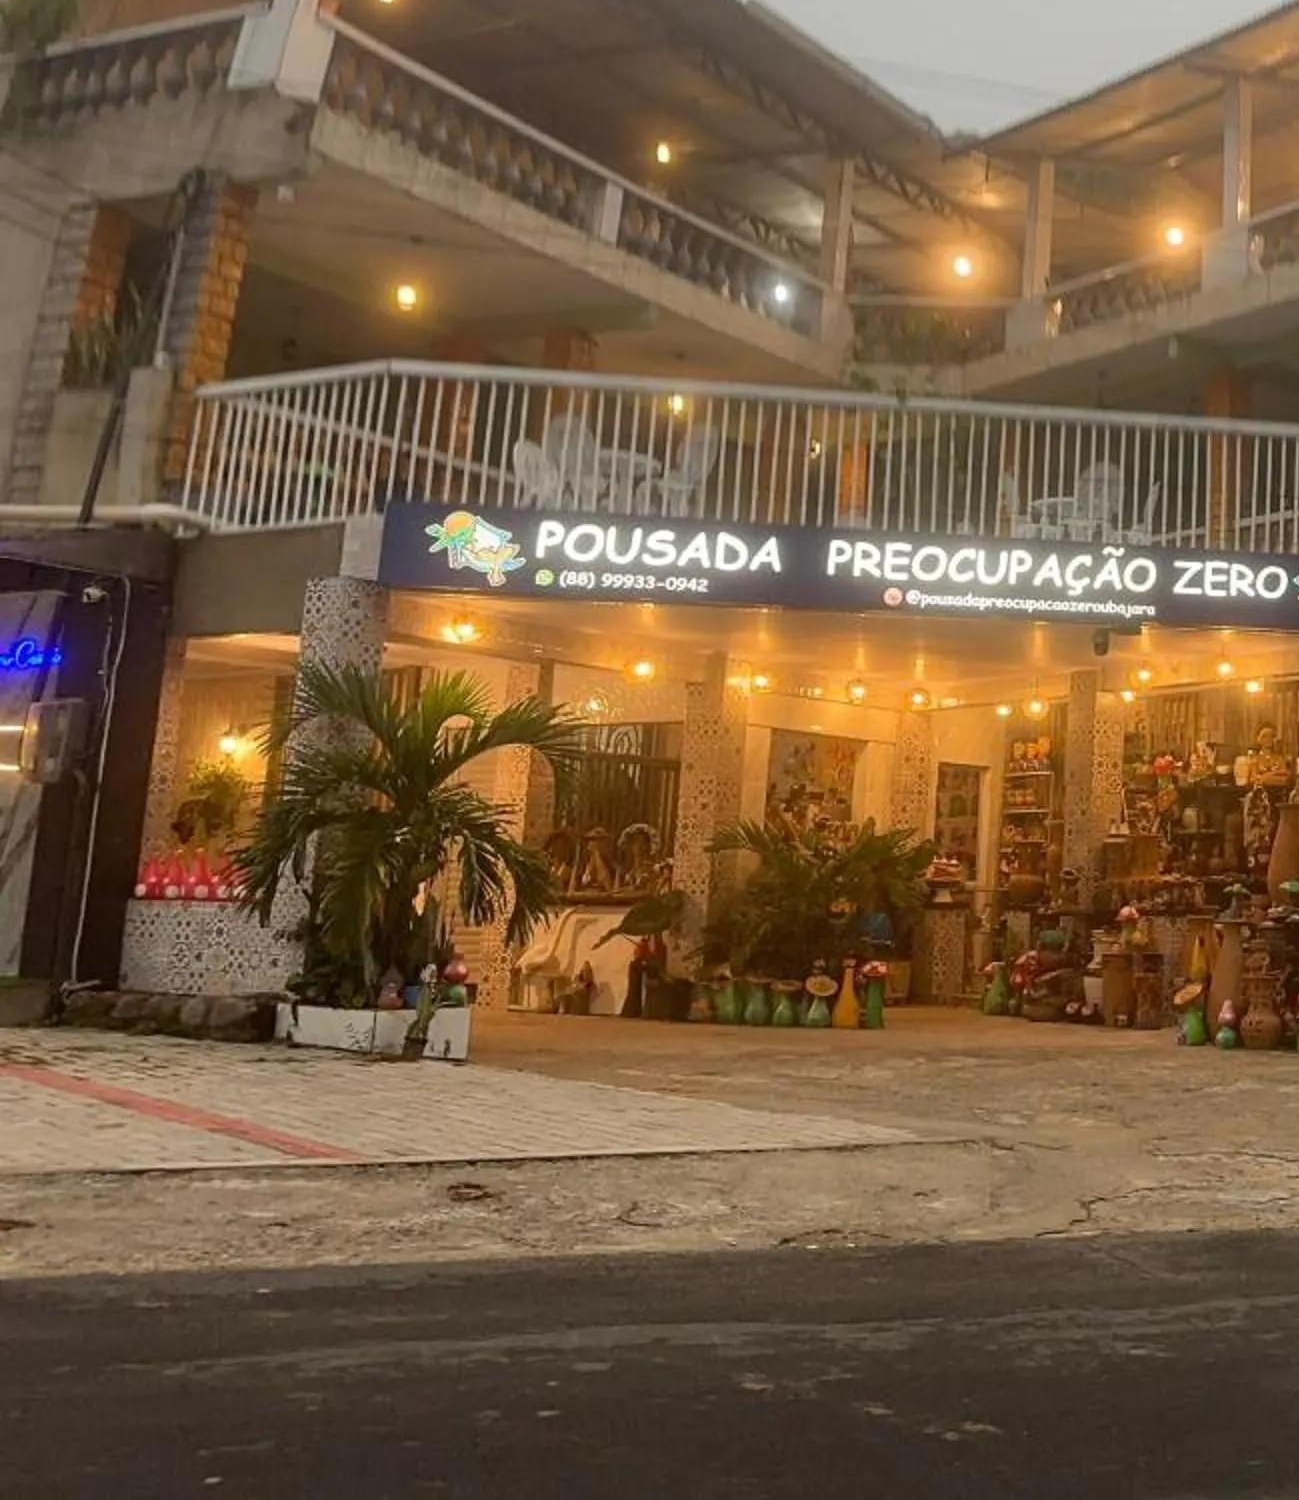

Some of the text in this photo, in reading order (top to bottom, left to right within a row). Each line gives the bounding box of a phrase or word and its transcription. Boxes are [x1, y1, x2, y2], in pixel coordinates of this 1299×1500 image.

[535, 520, 1289, 599] POUSADA PREOCUPAÇÃO ZERO
[559, 570, 709, 593] (88) 99933-0942
